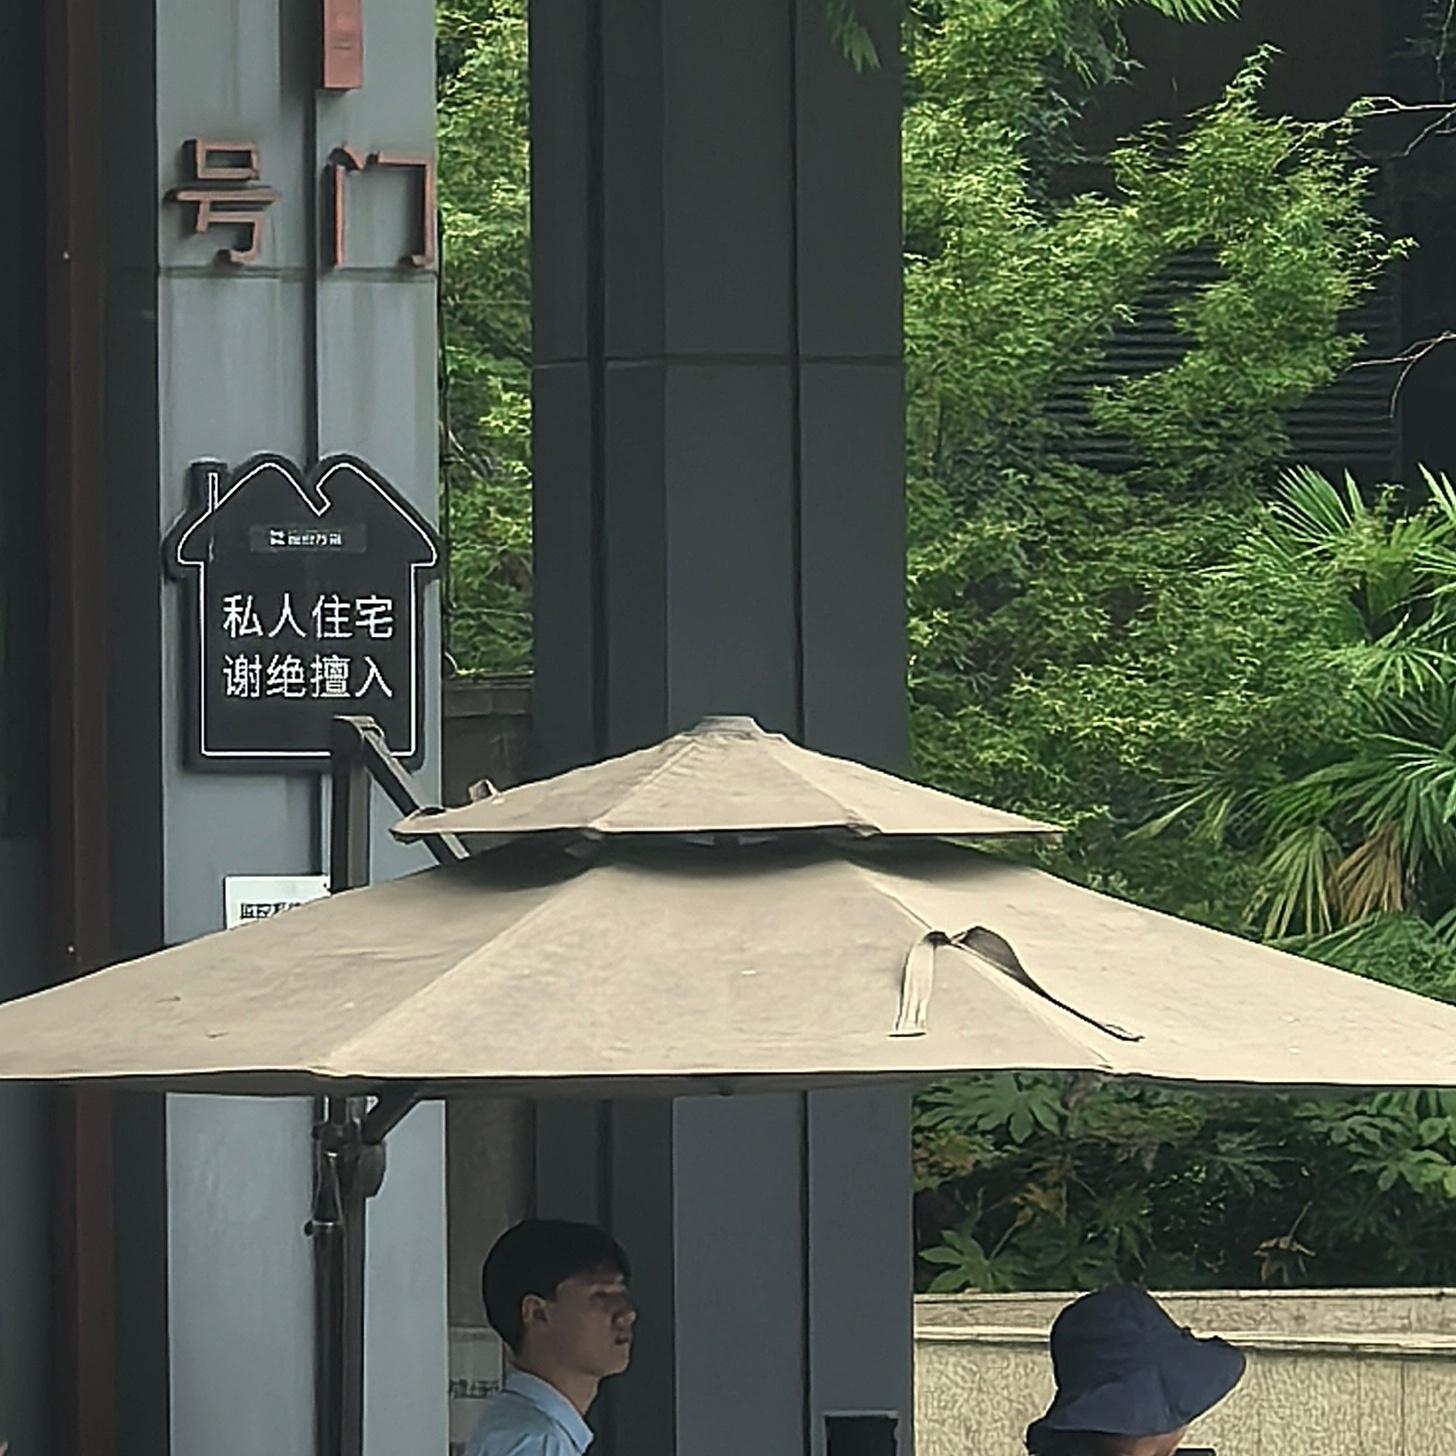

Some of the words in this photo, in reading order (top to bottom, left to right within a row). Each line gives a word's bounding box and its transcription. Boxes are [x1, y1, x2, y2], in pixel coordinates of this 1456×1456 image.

[174, 140, 436, 266] 号门
[221, 593, 394, 639] 私人住宅
[221, 653, 394, 699] 谢绝擅入
